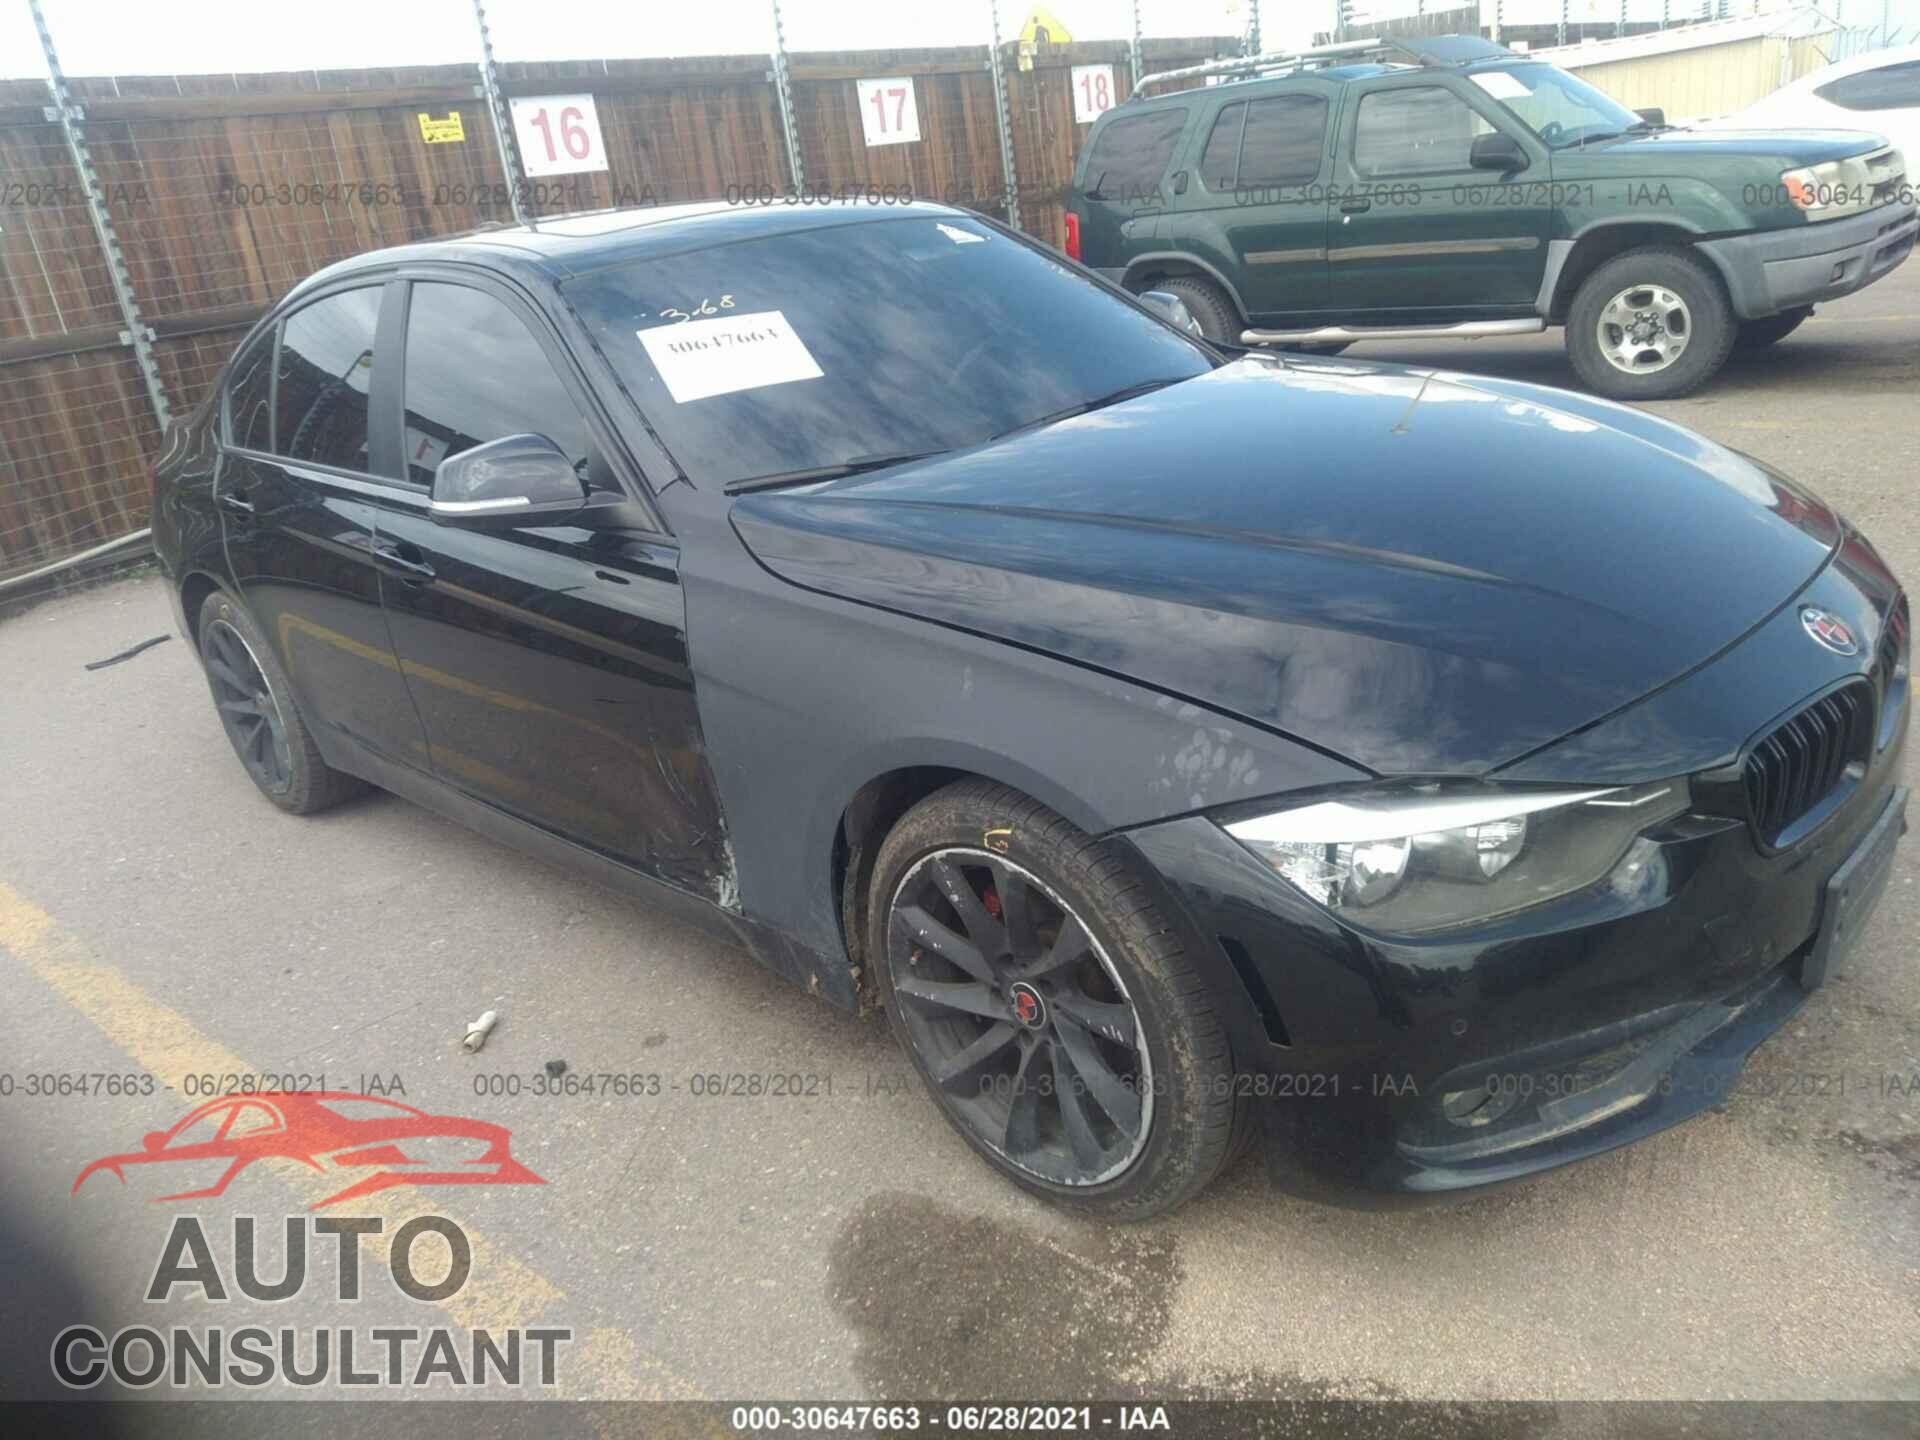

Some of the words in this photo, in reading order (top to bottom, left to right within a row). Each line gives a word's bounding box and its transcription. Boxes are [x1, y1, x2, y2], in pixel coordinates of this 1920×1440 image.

[870, 88, 906, 133] 17
[1081, 73, 1109, 112] 18
[530, 107, 590, 161] 16
